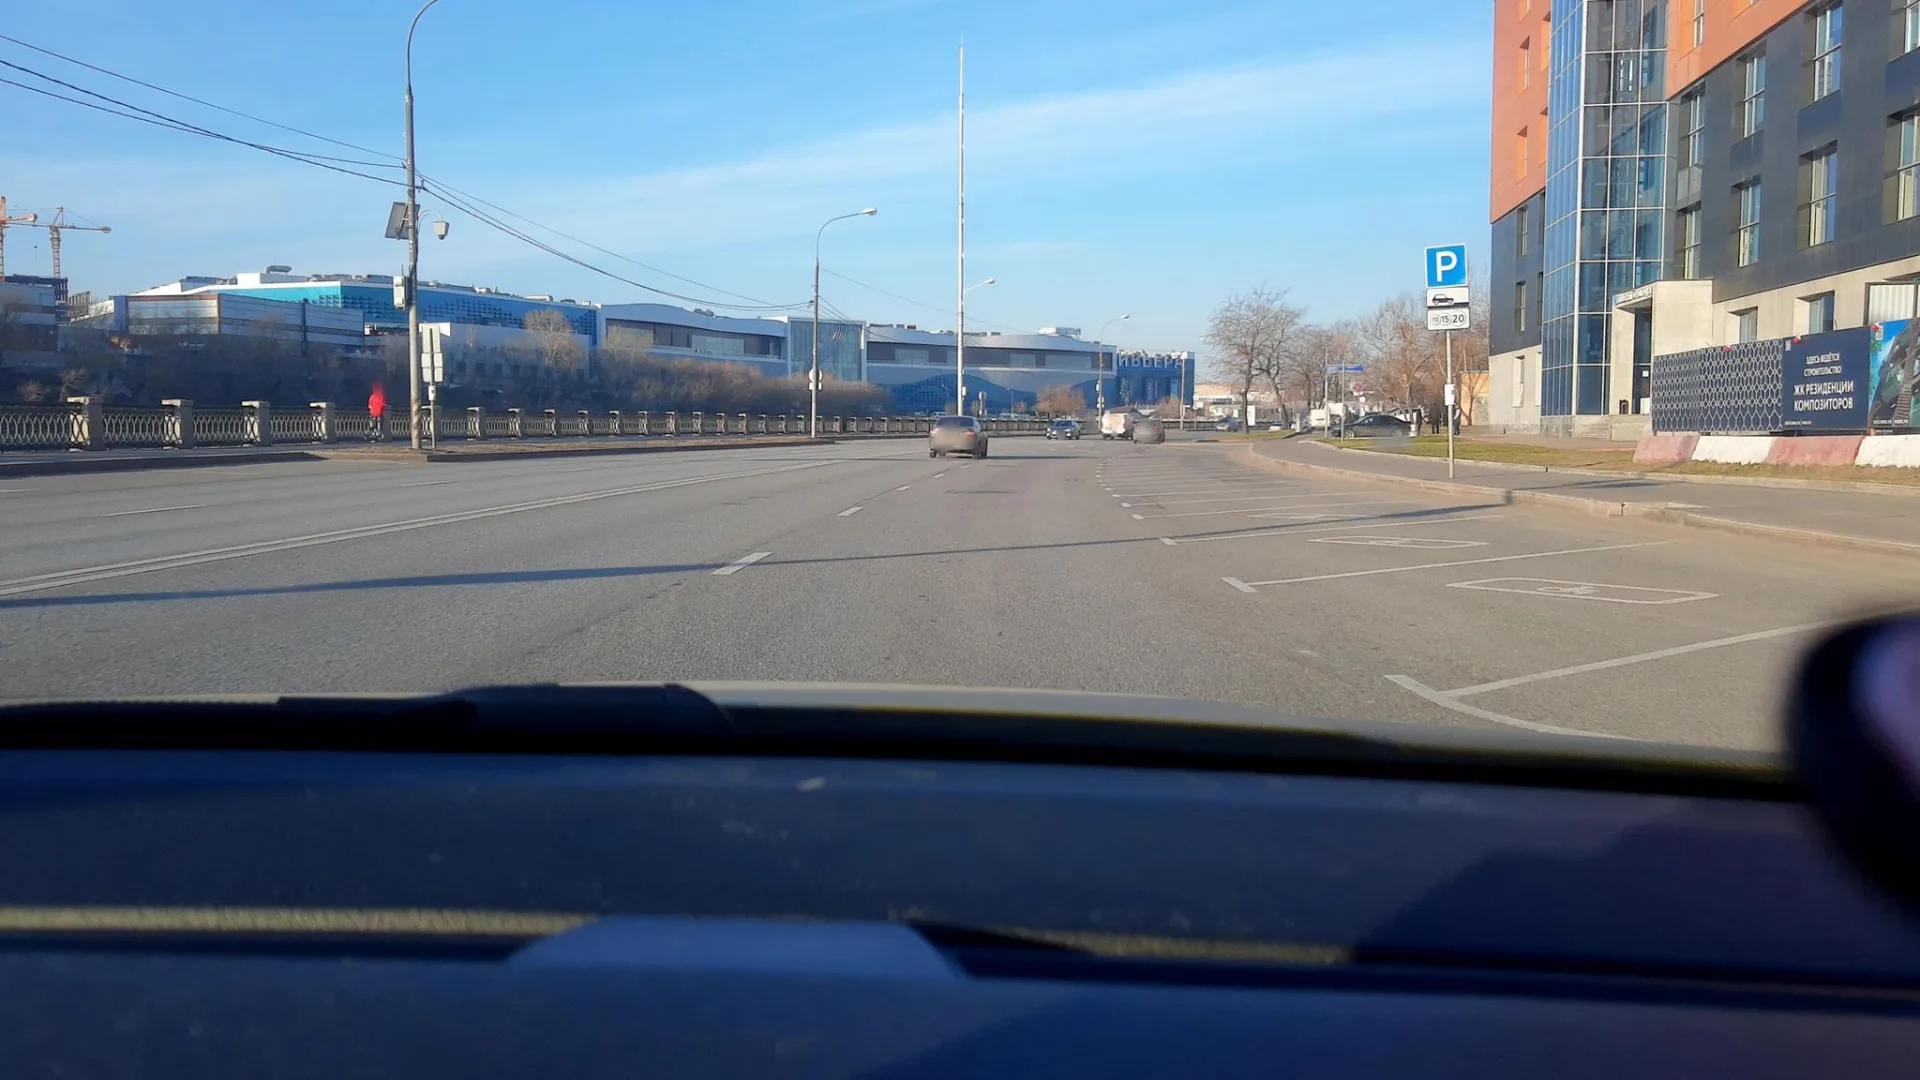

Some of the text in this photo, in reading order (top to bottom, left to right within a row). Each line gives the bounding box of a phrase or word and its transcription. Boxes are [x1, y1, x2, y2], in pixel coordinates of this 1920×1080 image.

[1436, 250, 1458, 283] P
[1441, 315, 1450, 323] 15
[1452, 314, 1465, 324] 20
[1806, 355, 1820, 364] ЗДЕСЬ
[1804, 366, 1842, 377] СТРОИТЕЛЬСТВО
[1793, 380, 1854, 396] ЖК РЕЗИДЕНЦИИ
[1794, 397, 1853, 412] КОМПОЗИТОРОВ
